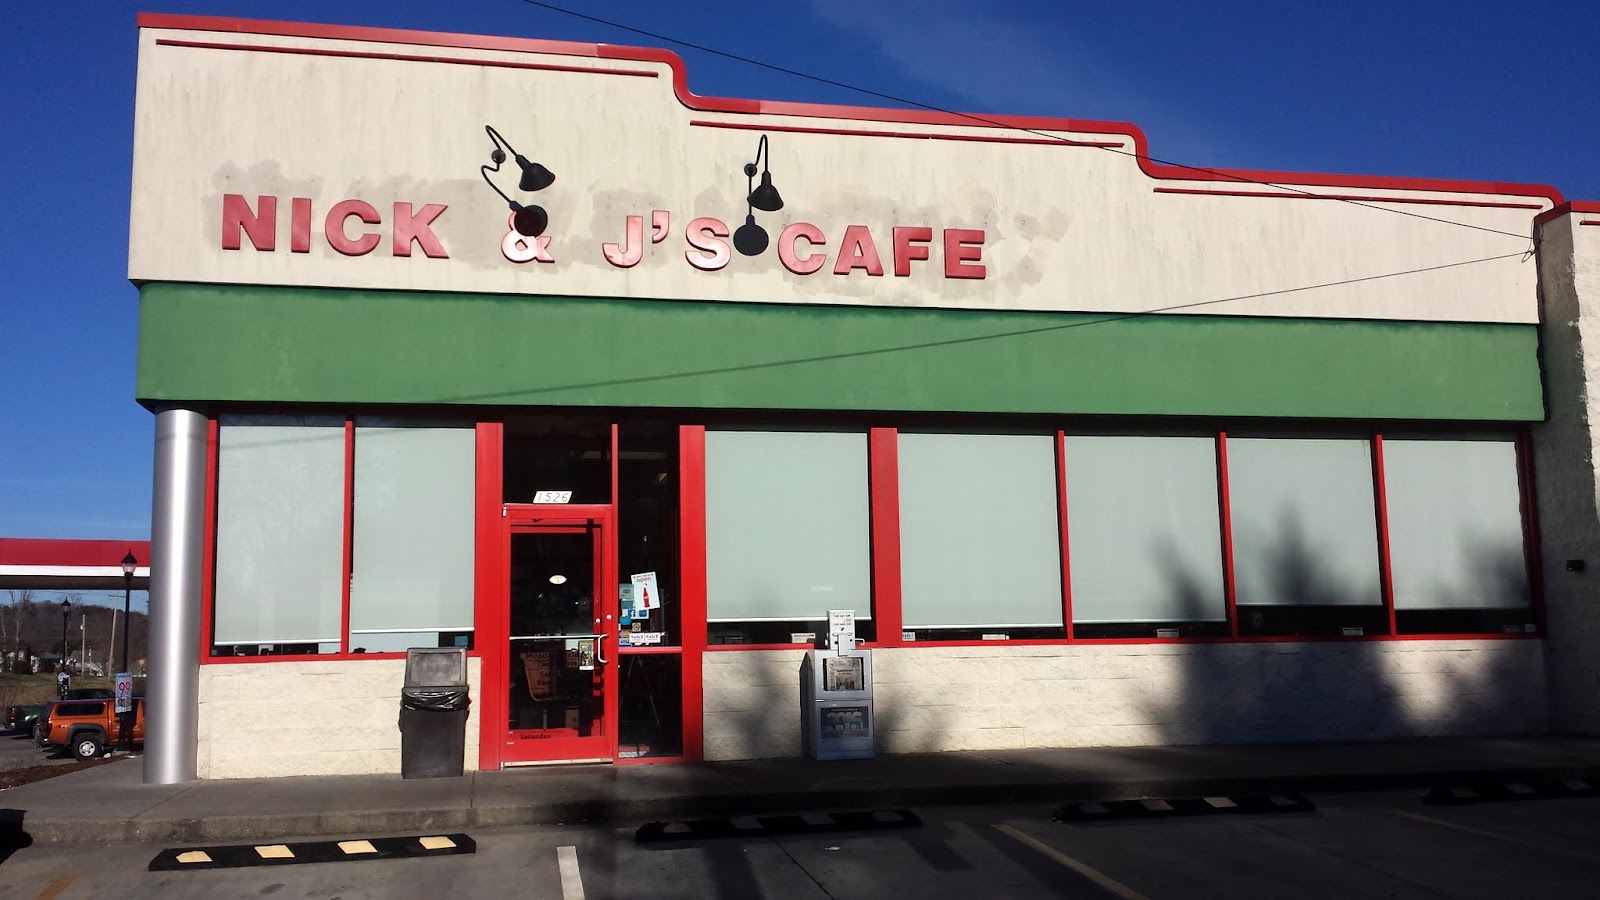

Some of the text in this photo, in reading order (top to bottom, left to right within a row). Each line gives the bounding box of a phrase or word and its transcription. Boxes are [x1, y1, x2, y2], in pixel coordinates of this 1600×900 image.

[222, 193, 987, 279] NICK & J'S CAFE
[537, 492, 569, 502] 1526
